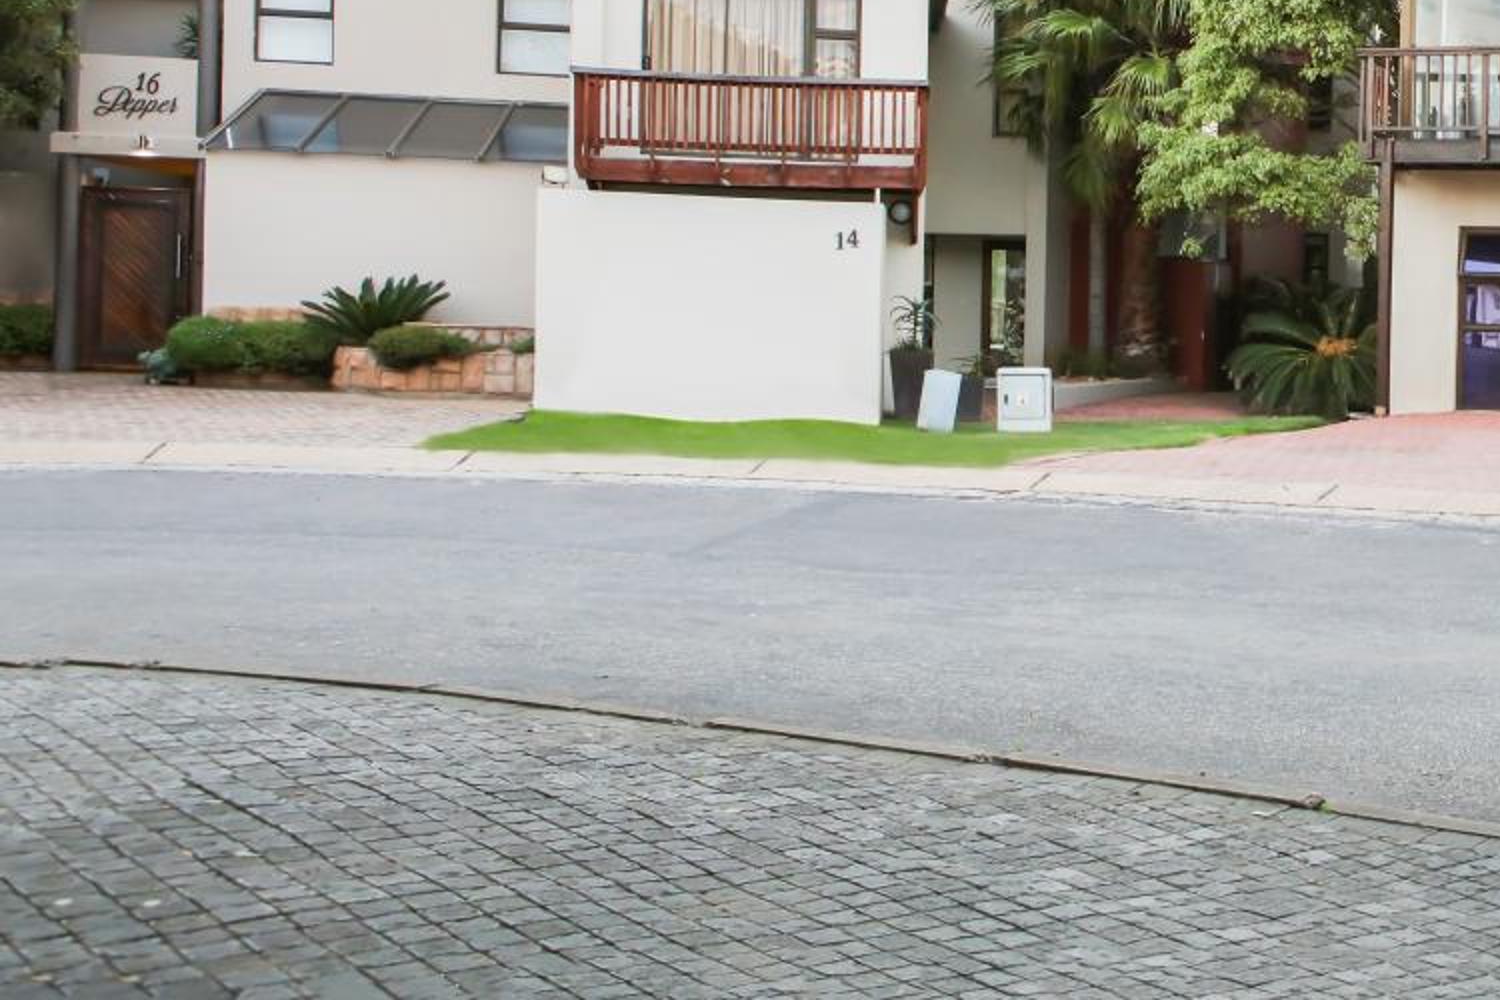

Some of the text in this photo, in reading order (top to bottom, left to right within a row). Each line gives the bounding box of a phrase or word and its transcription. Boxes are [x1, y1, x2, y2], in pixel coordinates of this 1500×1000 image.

[135, 71, 161, 95] 16
[93, 85, 178, 120] Pepper
[834, 229, 860, 251] 14
